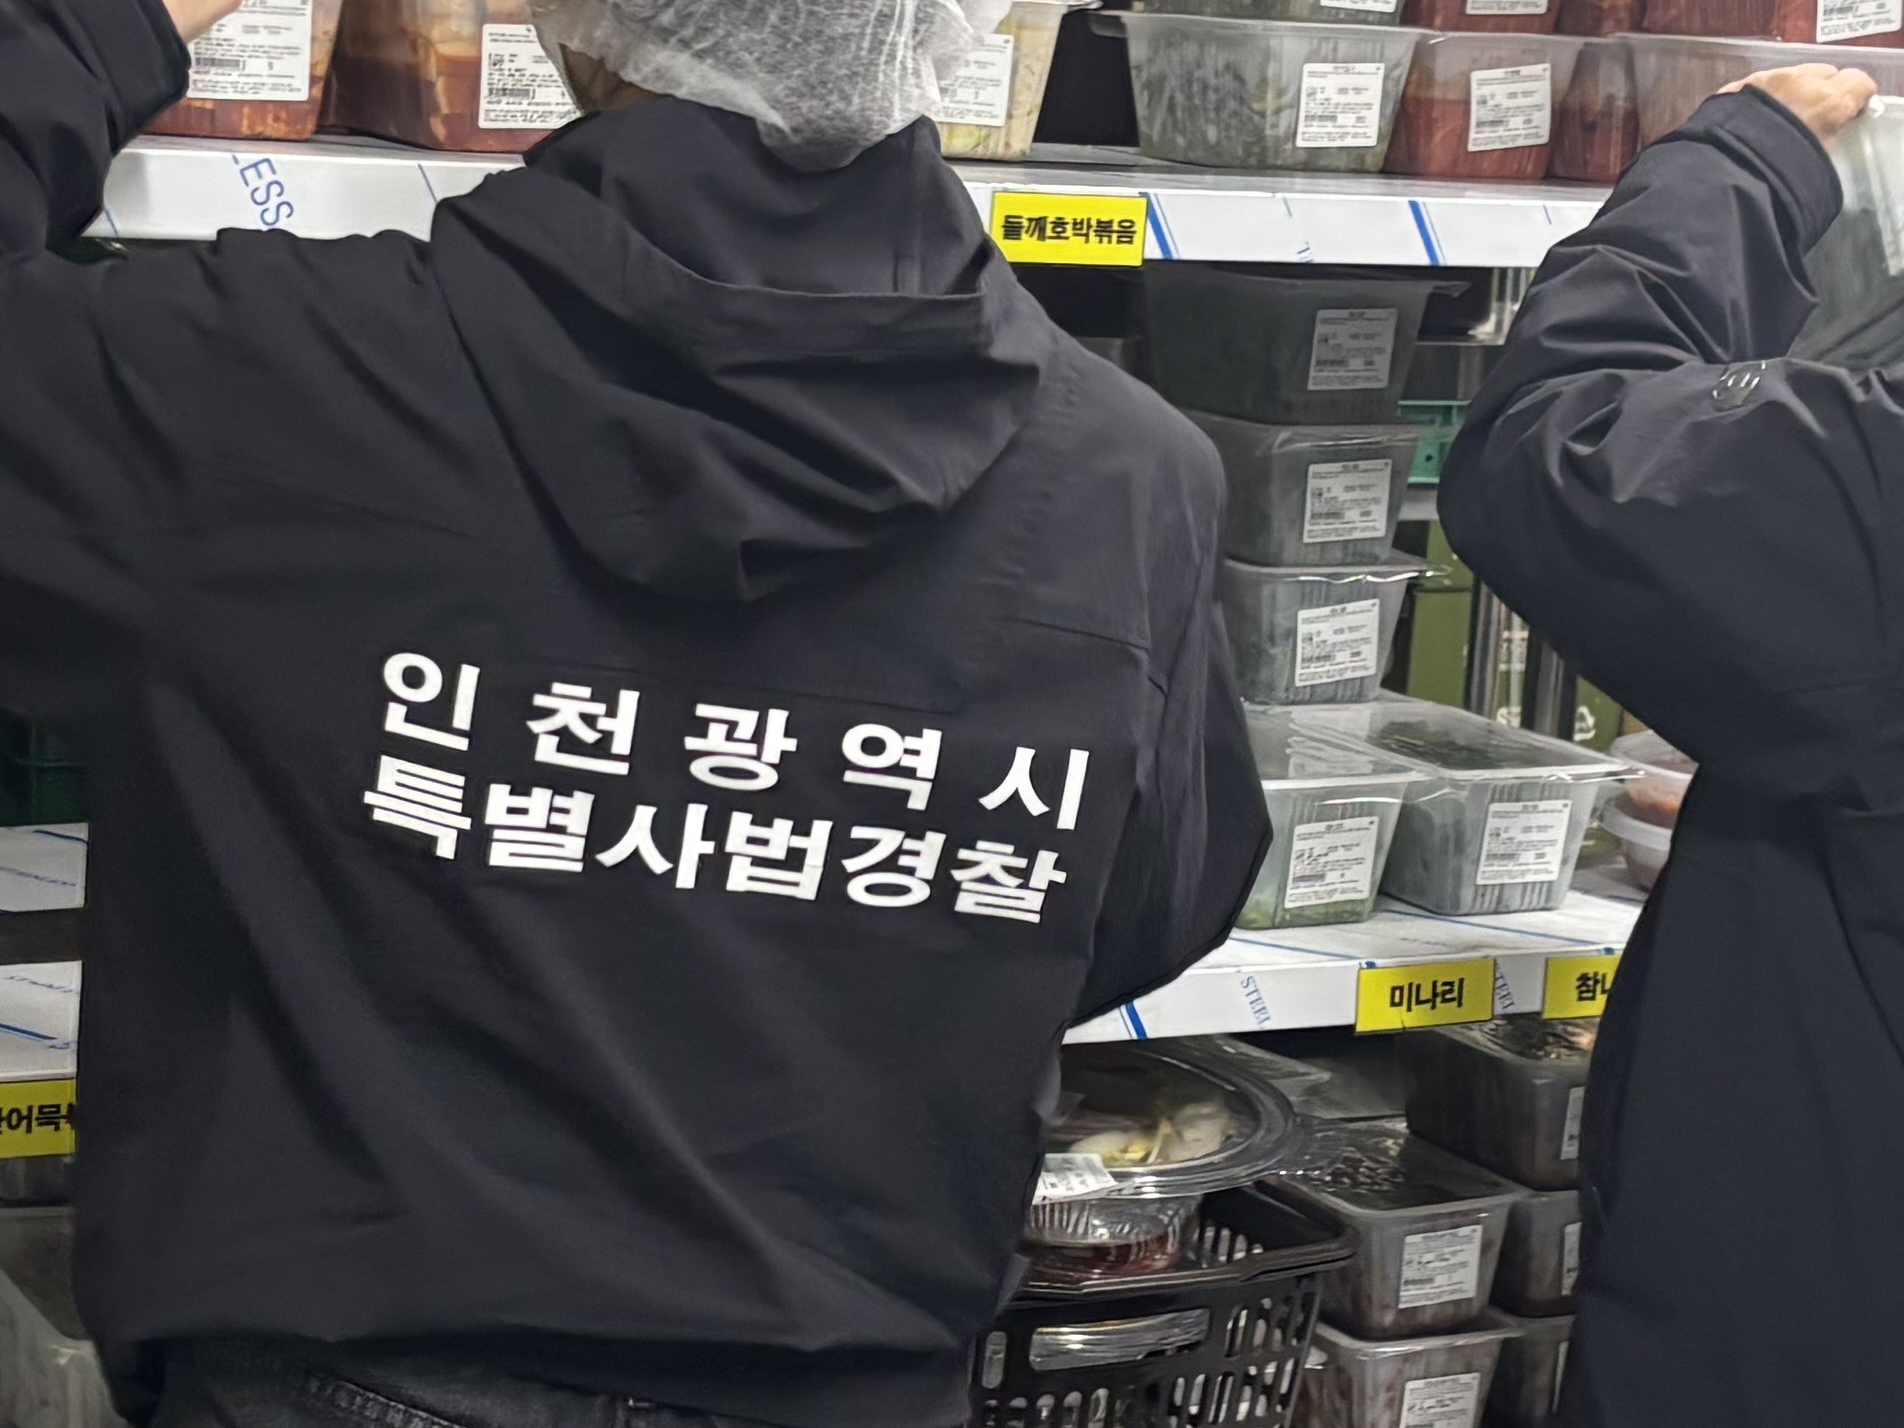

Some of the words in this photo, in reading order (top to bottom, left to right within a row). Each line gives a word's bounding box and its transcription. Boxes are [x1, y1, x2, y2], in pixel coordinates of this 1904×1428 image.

[232, 154, 294, 229] ESS
[1001, 214, 1138, 245] 들깨호박볶음
[382, 650, 1090, 831] 인천광역시
[362, 754, 1068, 924] 특별사법경찰
[1389, 977, 1465, 1013] 미나리
